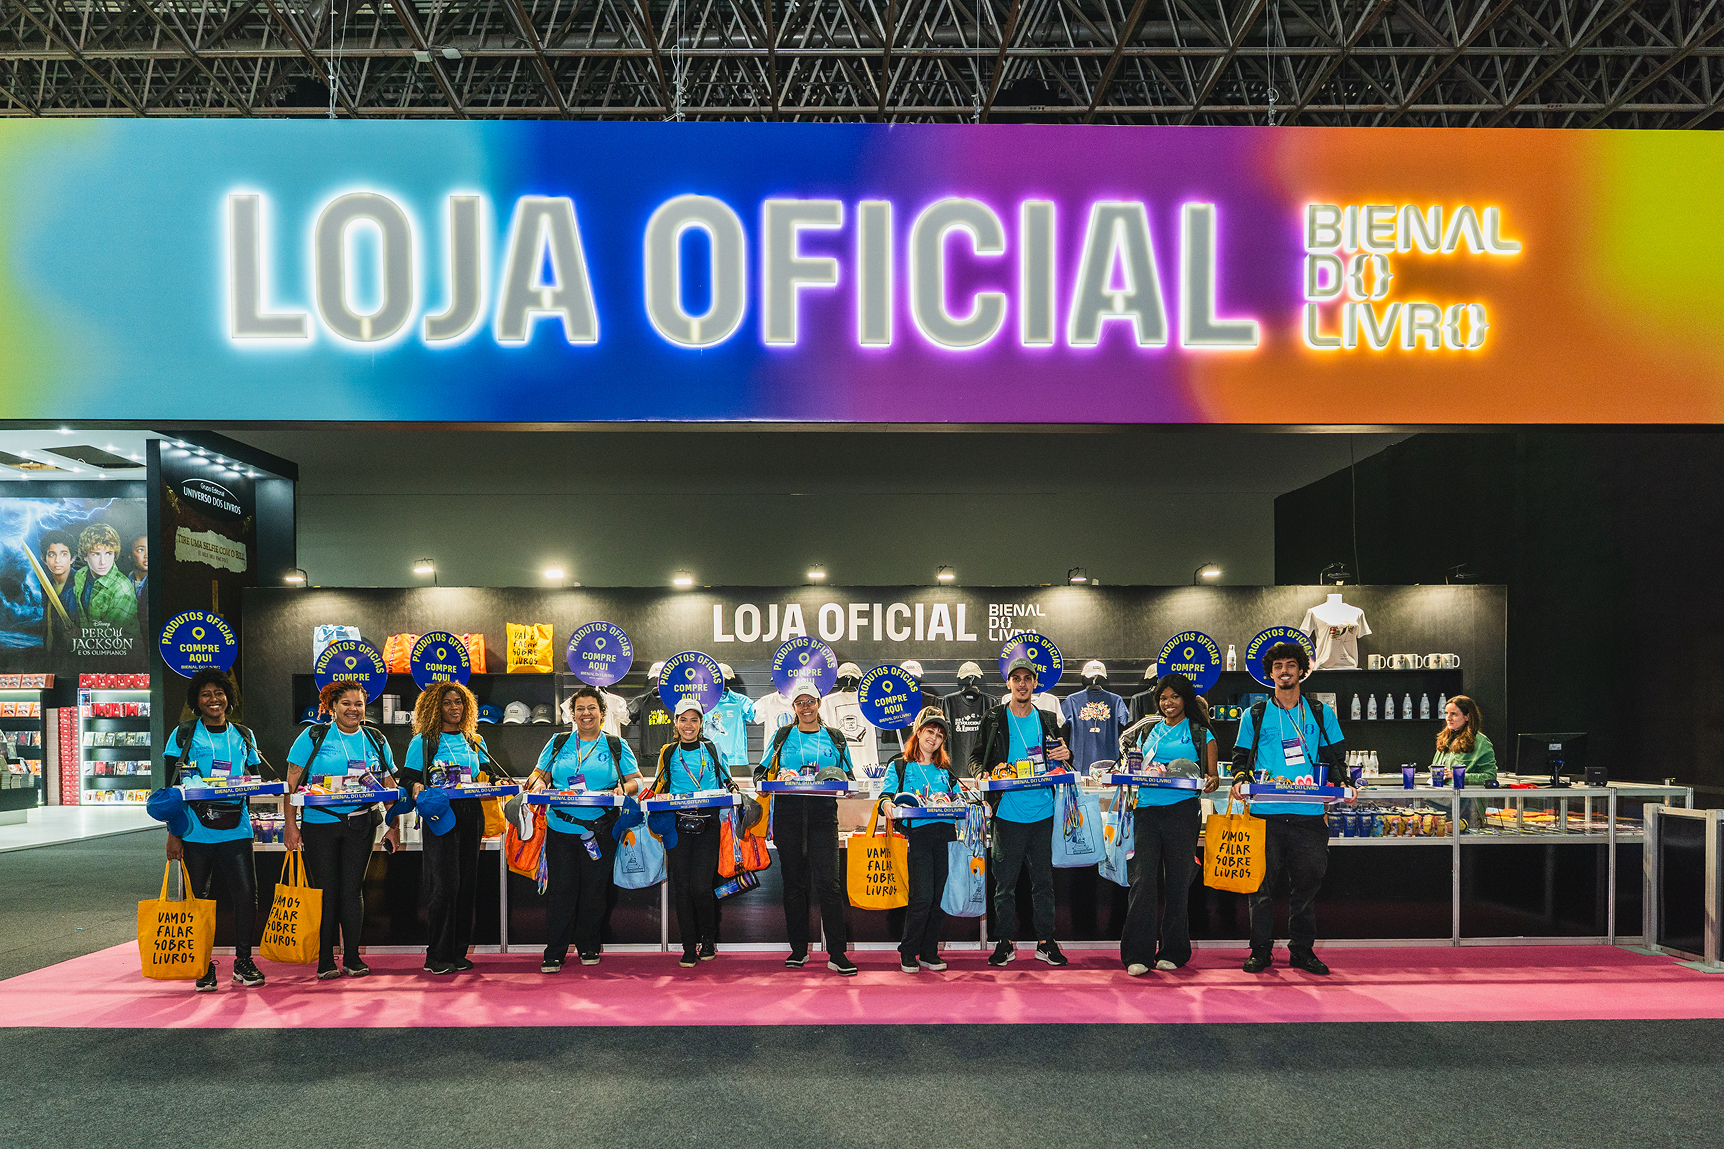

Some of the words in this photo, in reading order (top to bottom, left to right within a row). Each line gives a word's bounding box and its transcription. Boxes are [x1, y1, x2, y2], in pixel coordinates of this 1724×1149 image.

[1304, 204, 1522, 254] BIENAL
[228, 191, 598, 344] LOJA
[644, 194, 1258, 348] OFICIAL
[183, 486, 211, 504] UNIVERSO
[213, 497, 223, 509] DOS
[224, 501, 242, 515] LIVROS
[178, 534, 190, 545] TIRE
[191, 538, 202, 548] UMA
[203, 542, 218, 554] SELFIE
[219, 547, 230, 557] COM
[231, 549, 235, 557] O
[988, 604, 1046, 616] BIENAL
[93, 620, 110, 628] Disney
[162, 612, 203, 644] PRODUTOS
[206, 614, 235, 645] OFICIAS
[713, 603, 808, 642] LOJA
[818, 602, 977, 642] OFICIAL
[82, 627, 122, 638] PERCY
[70, 638, 133, 652] JACKSON
[569, 623, 607, 651] PRODUTOS
[609, 627, 631, 656] OFICIAS
[1248, 628, 1284, 659] PRODUTOS
[1287, 630, 1313, 656] OFICIAS
[180, 644, 220, 652] COMPRE
[412, 633, 446, 662] PRODUTOS
[448, 637, 469, 667] OFICIAS
[774, 638, 808, 670] PRODUTOS
[811, 640, 835, 668] OFICIAS
[1001, 634, 1039, 659] PRODUTOS
[1041, 639, 1061, 669] OFICIAS
[1159, 633, 1195, 664] PRODUTOS
[1198, 635, 1220, 665] OFICIAS
[189, 654, 212, 663] AQUI
[317, 642, 356, 674] PRODUTOS
[358, 644, 384, 674] OFICIAS
[582, 652, 616, 662] COMPRE
[426, 663, 457, 673] COMPRE
[589, 662, 608, 670] AQUI
[660, 653, 695, 685] PRODUTOS
[698, 656, 721, 684] OFICIAS
[788, 668, 822, 677] COMPRE
[1171, 663, 1205, 672] COMPRE
[432, 673, 450, 682] AQUI
[674, 684, 708, 692] COMPRE
[860, 667, 888, 702] PRODUTOS
[891, 667, 918, 692] OFICIAS
[875, 694, 908, 707] COMPRE
[885, 704, 903, 714] AQUI
[1219, 843, 1250, 855] FALAR
[1216, 855, 1251, 868] SOBRE
[867, 873, 896, 884] SOBRE
[158, 912, 193, 924] VAMOS
[270, 907, 298, 922] FALAR
[157, 926, 193, 938] FALAR
[267, 920, 297, 934] SOBRE
[154, 939, 194, 951] SOBRE
